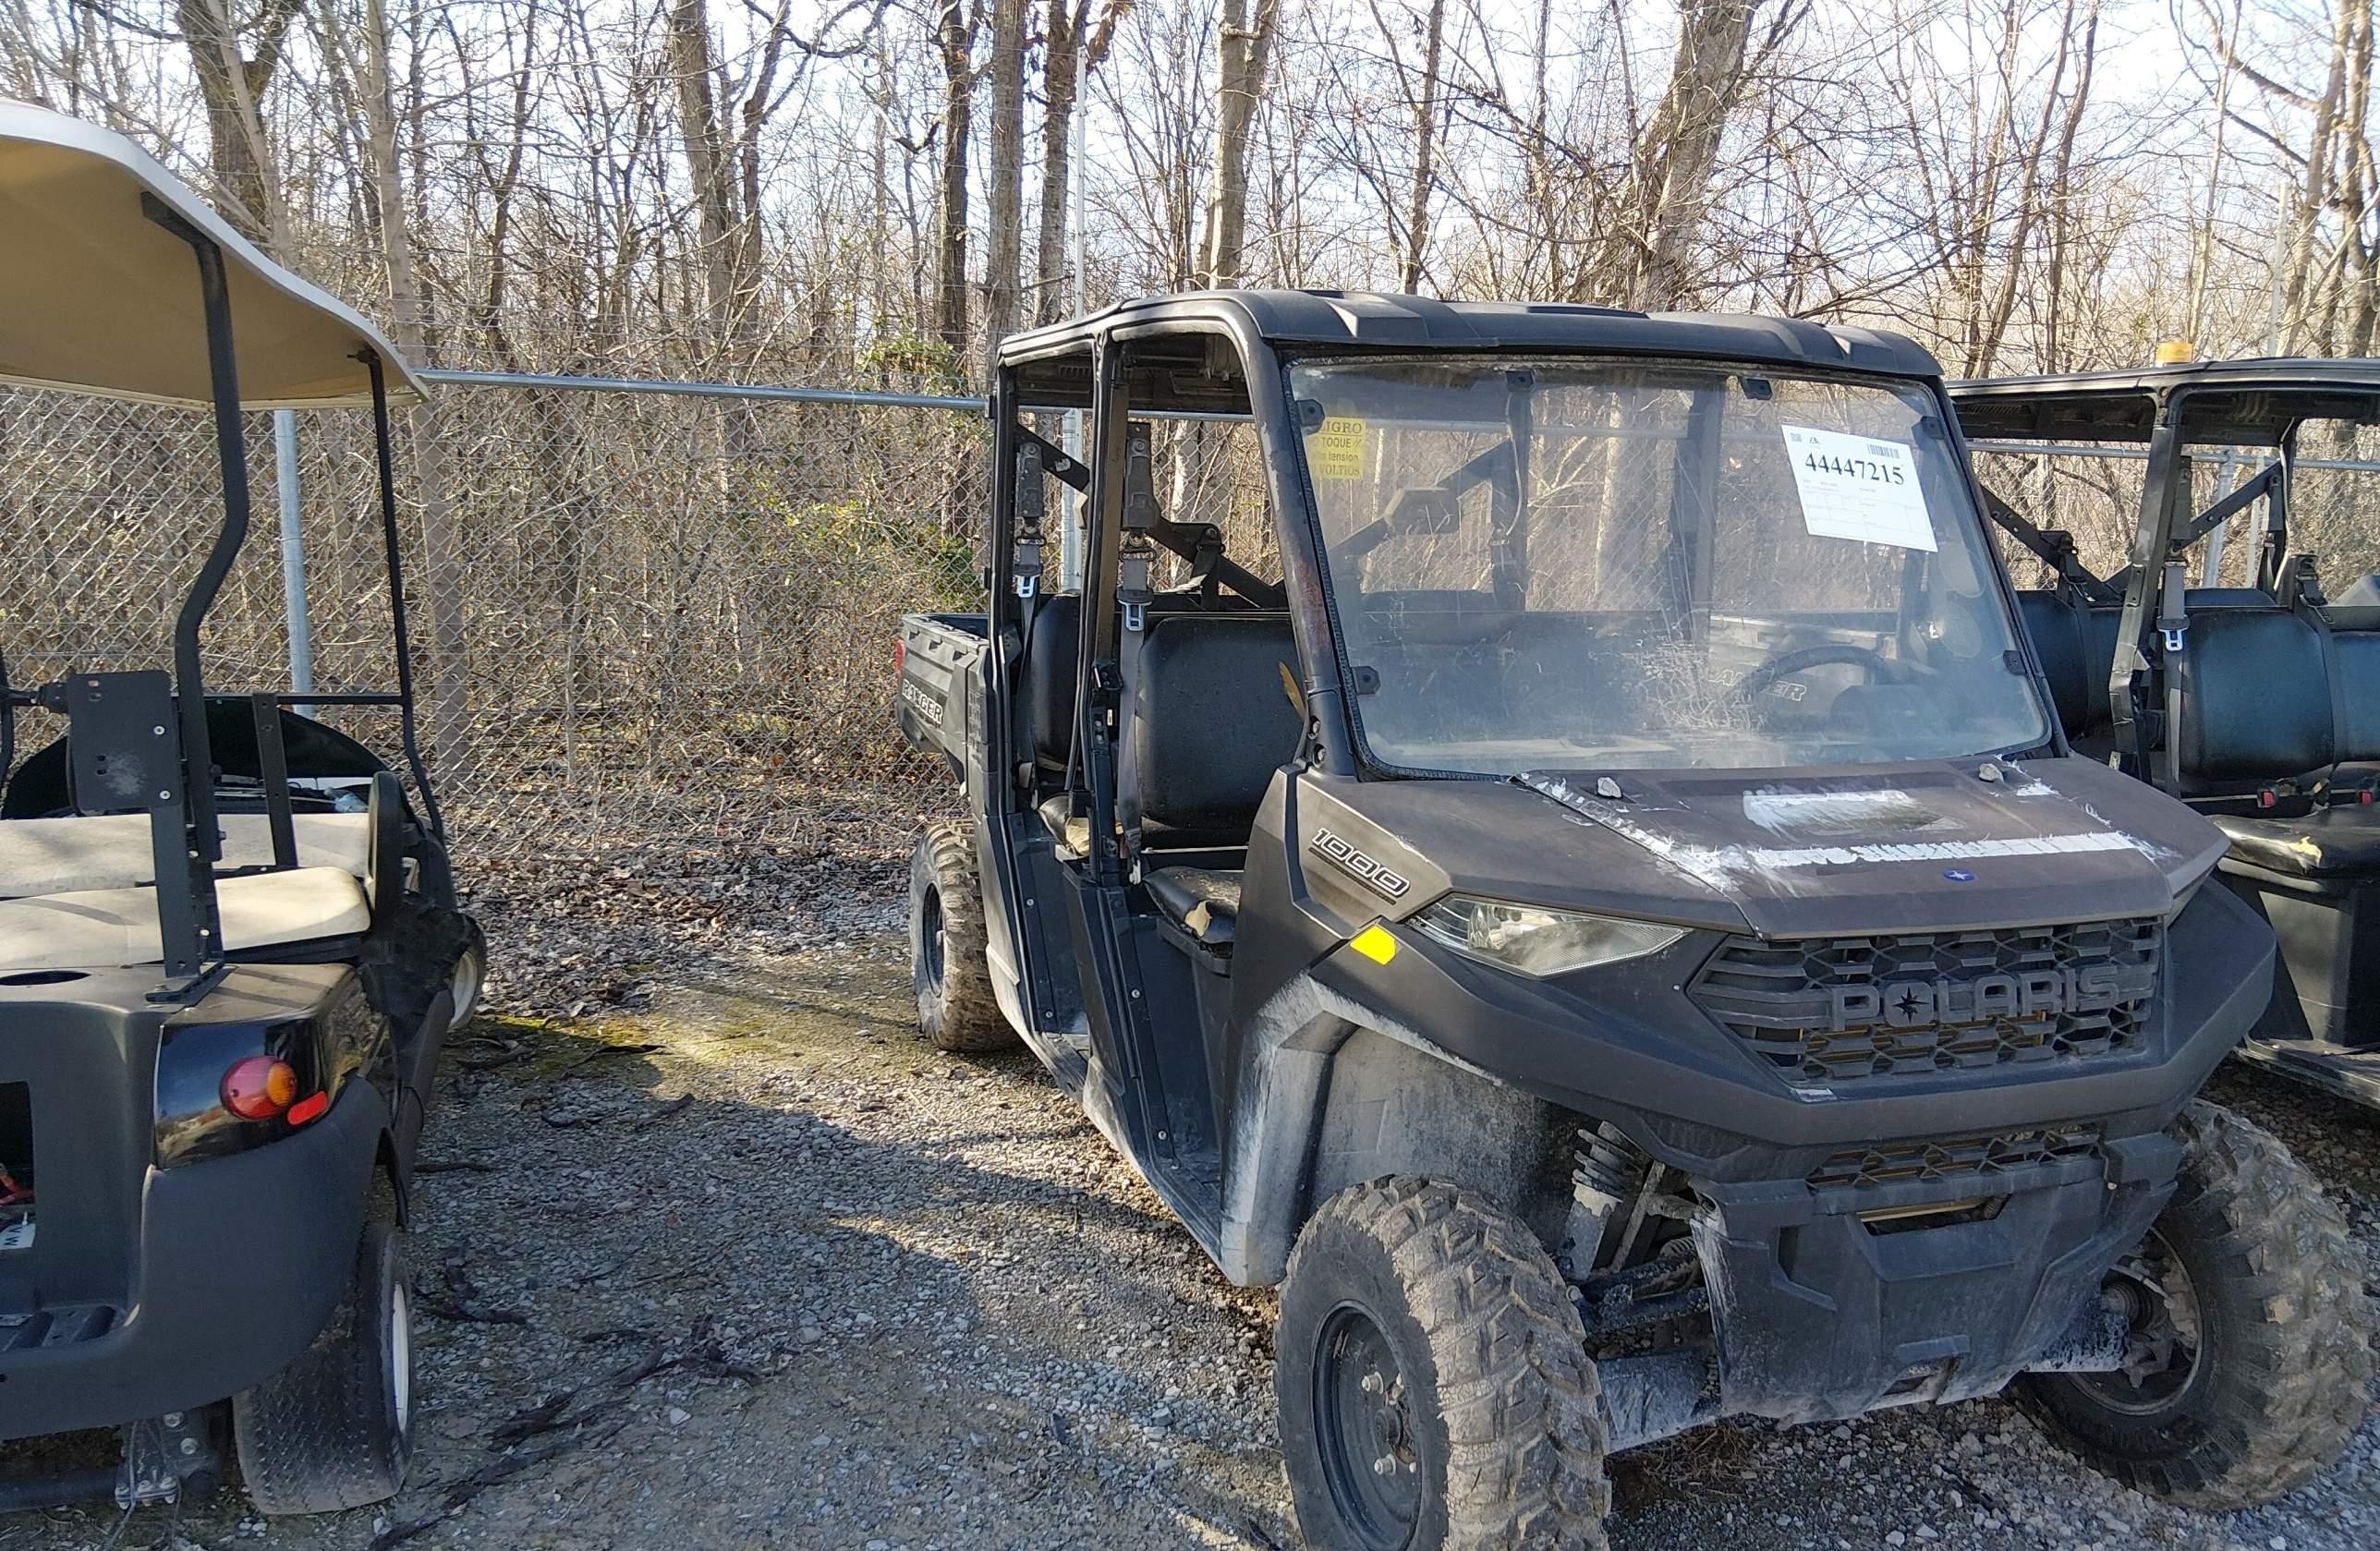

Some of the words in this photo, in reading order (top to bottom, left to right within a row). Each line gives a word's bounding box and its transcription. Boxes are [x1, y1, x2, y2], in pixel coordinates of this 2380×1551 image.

[1805, 452, 1904, 485] 44447215
[902, 678, 942, 724] RANGER
[1312, 827, 1411, 897] 1000
[1832, 963, 2119, 1032] POLARIS
